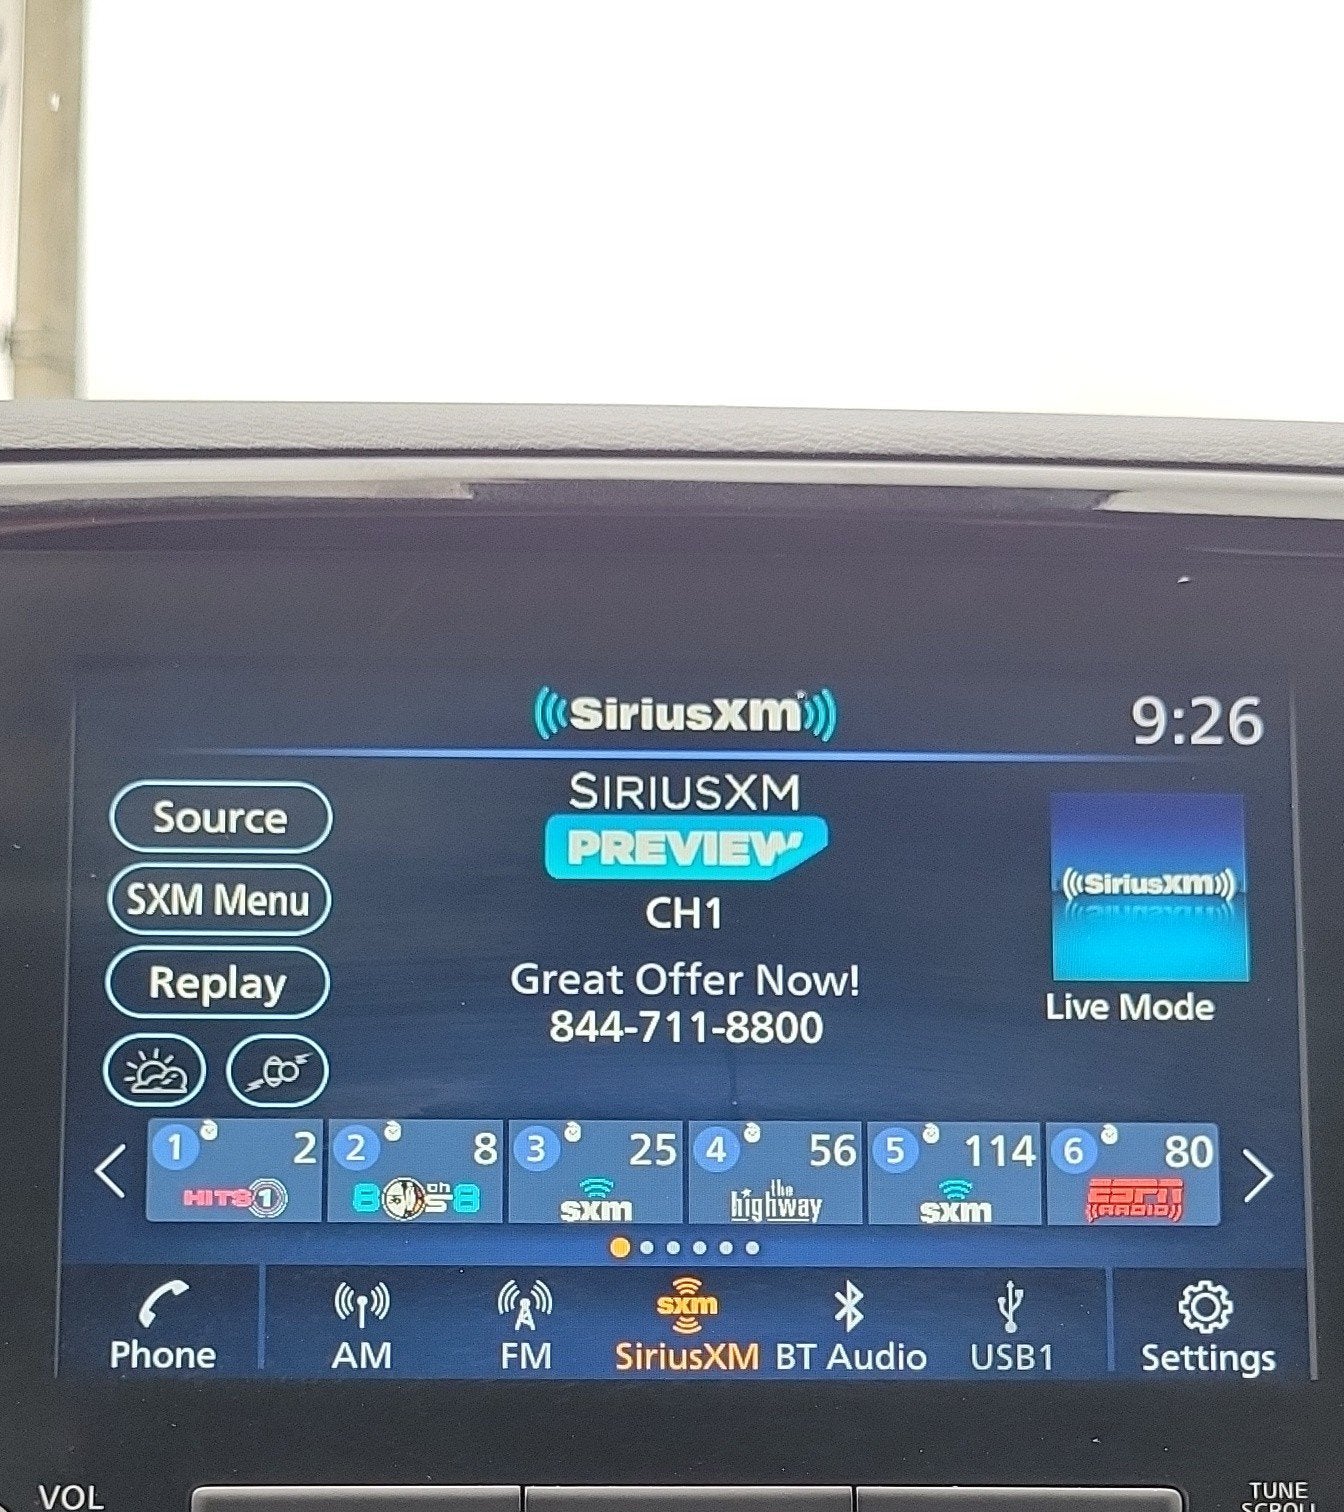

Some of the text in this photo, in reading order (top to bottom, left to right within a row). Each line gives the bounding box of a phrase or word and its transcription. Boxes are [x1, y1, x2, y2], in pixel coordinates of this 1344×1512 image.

[1131, 696, 1264, 746] 9:26
[568, 771, 802, 811] SIRIUSXM
[153, 800, 288, 834] Source
[567, 829, 803, 867] PREVIEW
[126, 883, 309, 917] SXM Menu
[645, 896, 721, 929] CH1
[150, 964, 287, 1008] Replay
[510, 961, 859, 997] Great Offer Now!
[1046, 992, 1215, 1020] Live Mode
[549, 1010, 824, 1044] 844-711-8800
[167, 1134, 182, 1160] 1
[293, 1131, 317, 1164] 2
[346, 1134, 367, 1161] 2
[473, 1132, 498, 1165] 8
[527, 1135, 546, 1162] 3
[629, 1133, 677, 1166] 25
[706, 1136, 727, 1162] 4
[810, 1133, 857, 1167] 56
[886, 1137, 905, 1164] 5
[965, 1135, 1036, 1167] 114
[1064, 1137, 1084, 1164] 6
[1165, 1135, 1213, 1168] 80
[770, 1179, 794, 1197] the
[730, 1190, 823, 1223] highway
[110, 1340, 216, 1369] Phone
[331, 1342, 392, 1369] AM
[502, 1342, 552, 1370] FM
[616, 1341, 759, 1370] SiriusXM
[777, 1340, 927, 1371] BT Audio
[971, 1343, 1052, 1371] USB1
[1142, 1343, 1276, 1378] Settings
[38, 1484, 105, 1511] VOL
[1249, 1481, 1309, 1499] TUNE
